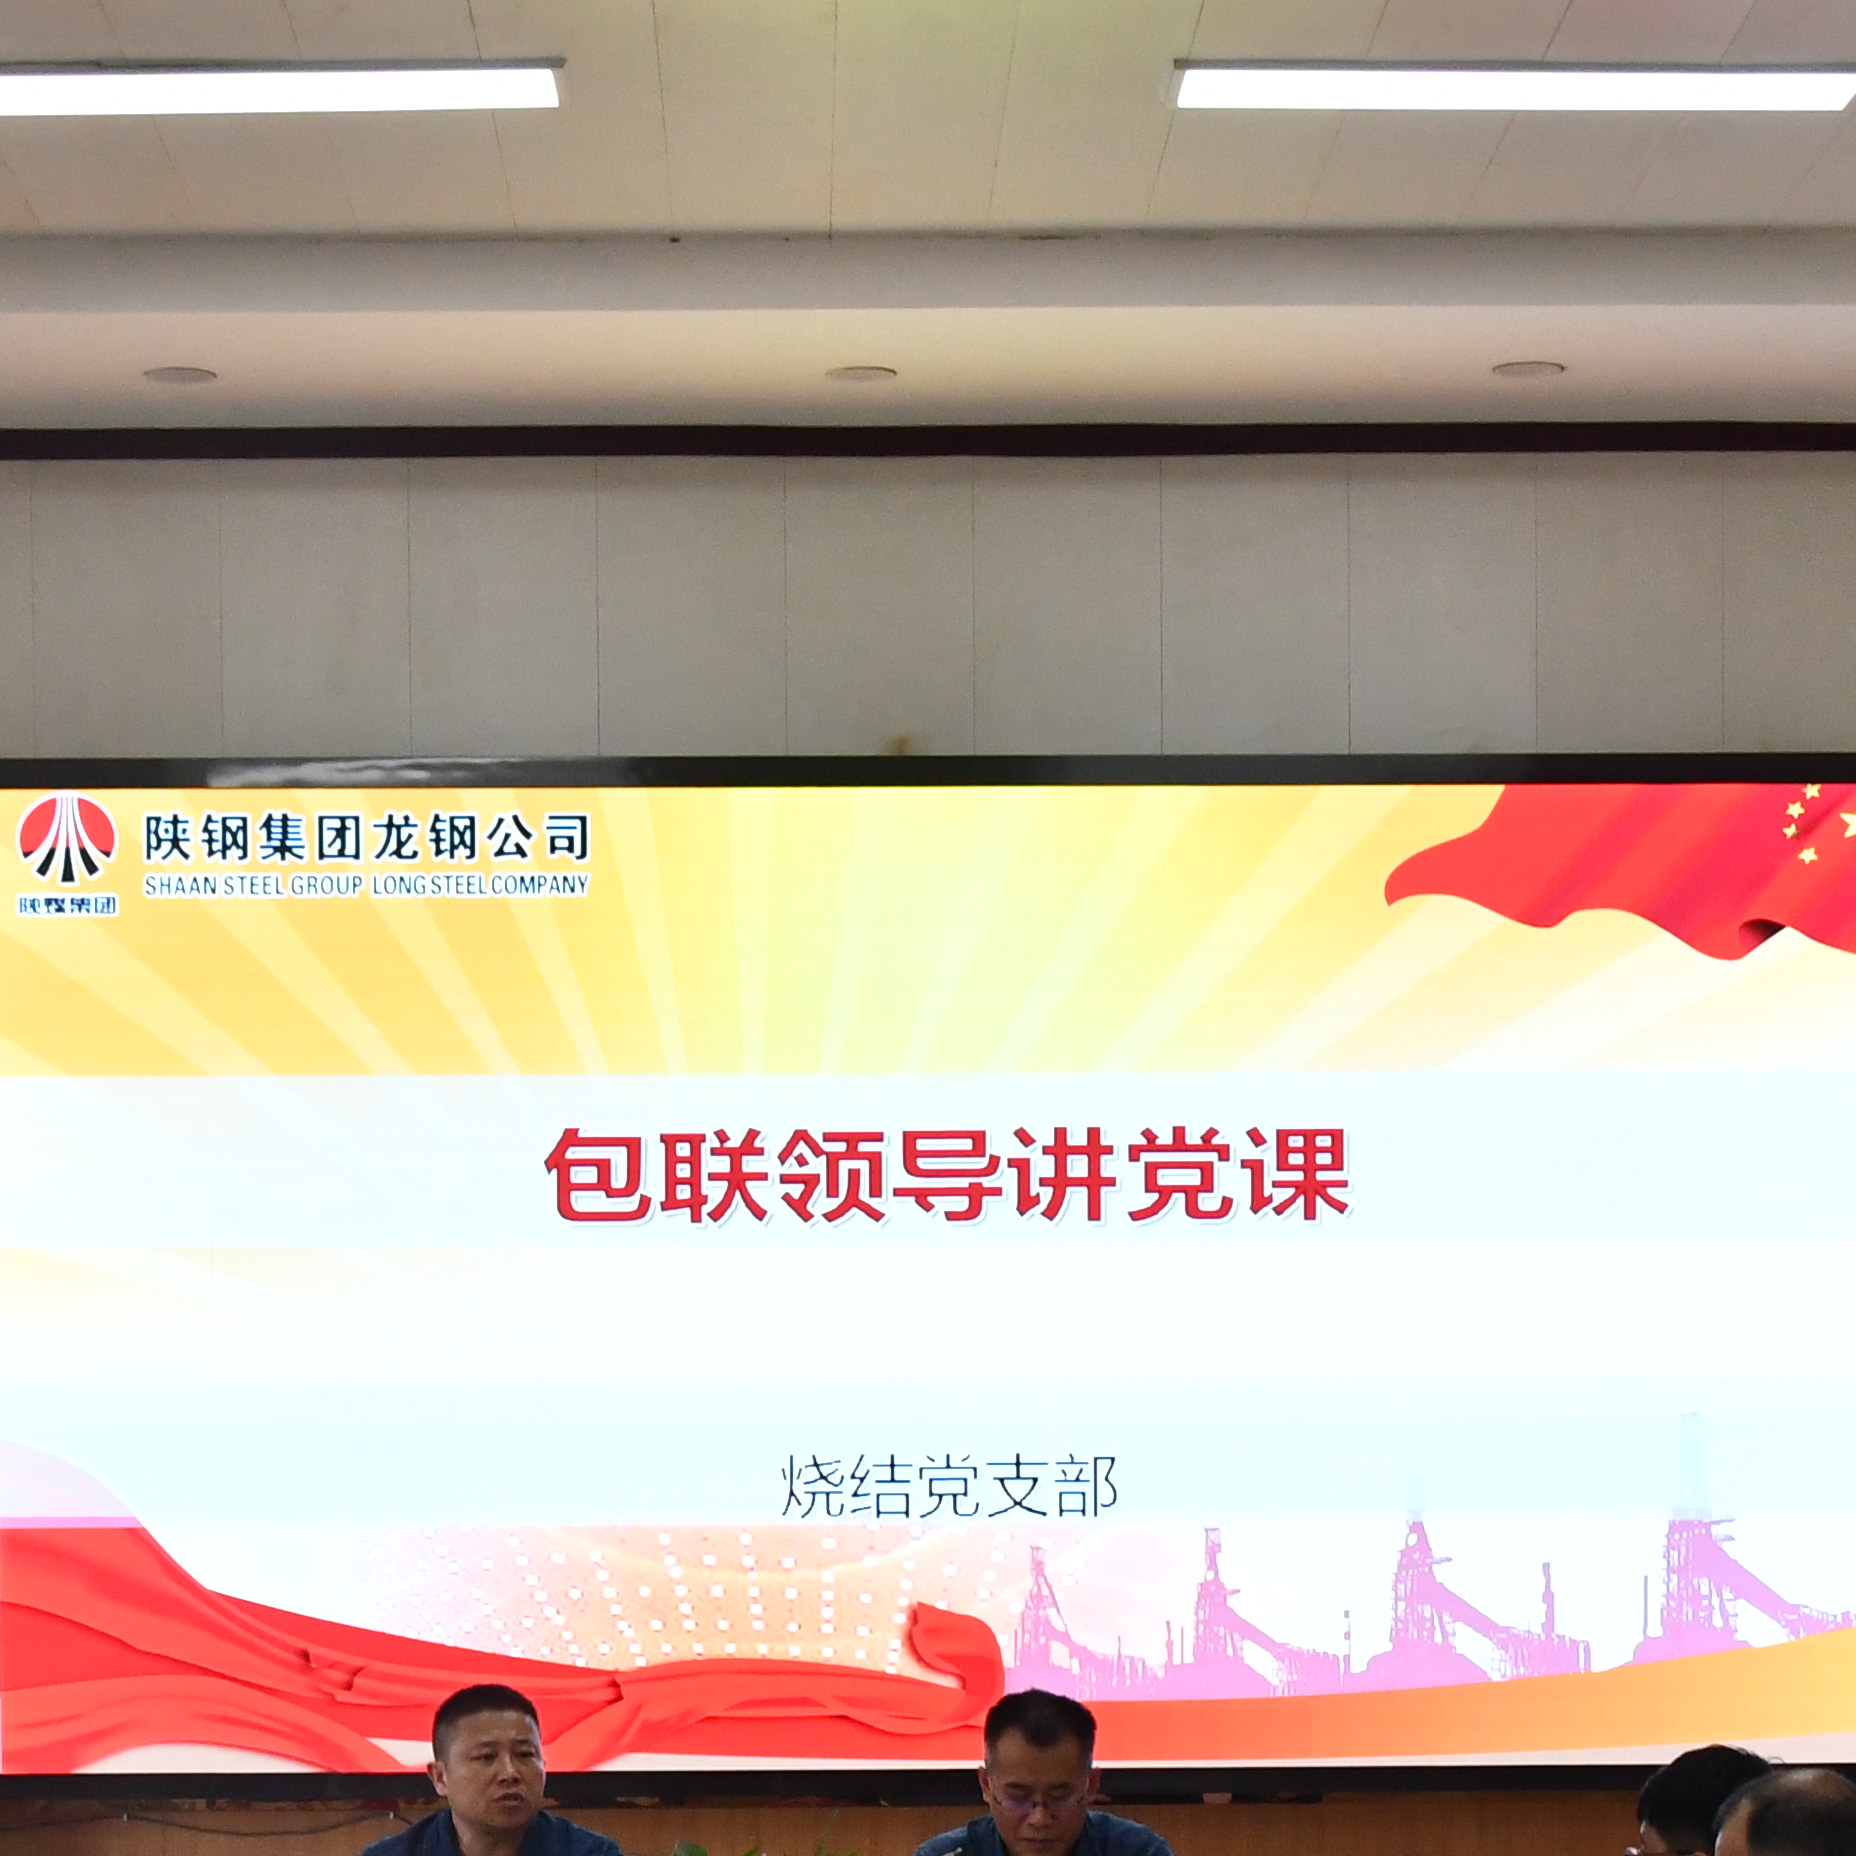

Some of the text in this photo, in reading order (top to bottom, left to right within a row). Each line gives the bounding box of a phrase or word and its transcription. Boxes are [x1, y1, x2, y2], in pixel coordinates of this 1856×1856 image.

[146, 813, 588, 861] 陕钢集团龙钢公司
[145, 875, 217, 895] SHAAN
[224, 875, 285, 895] STEEL
[292, 875, 363, 895] GROUP
[544, 1126, 1349, 1224] 包联领导讲党课
[781, 1452, 1119, 1519] 烧结党支部
